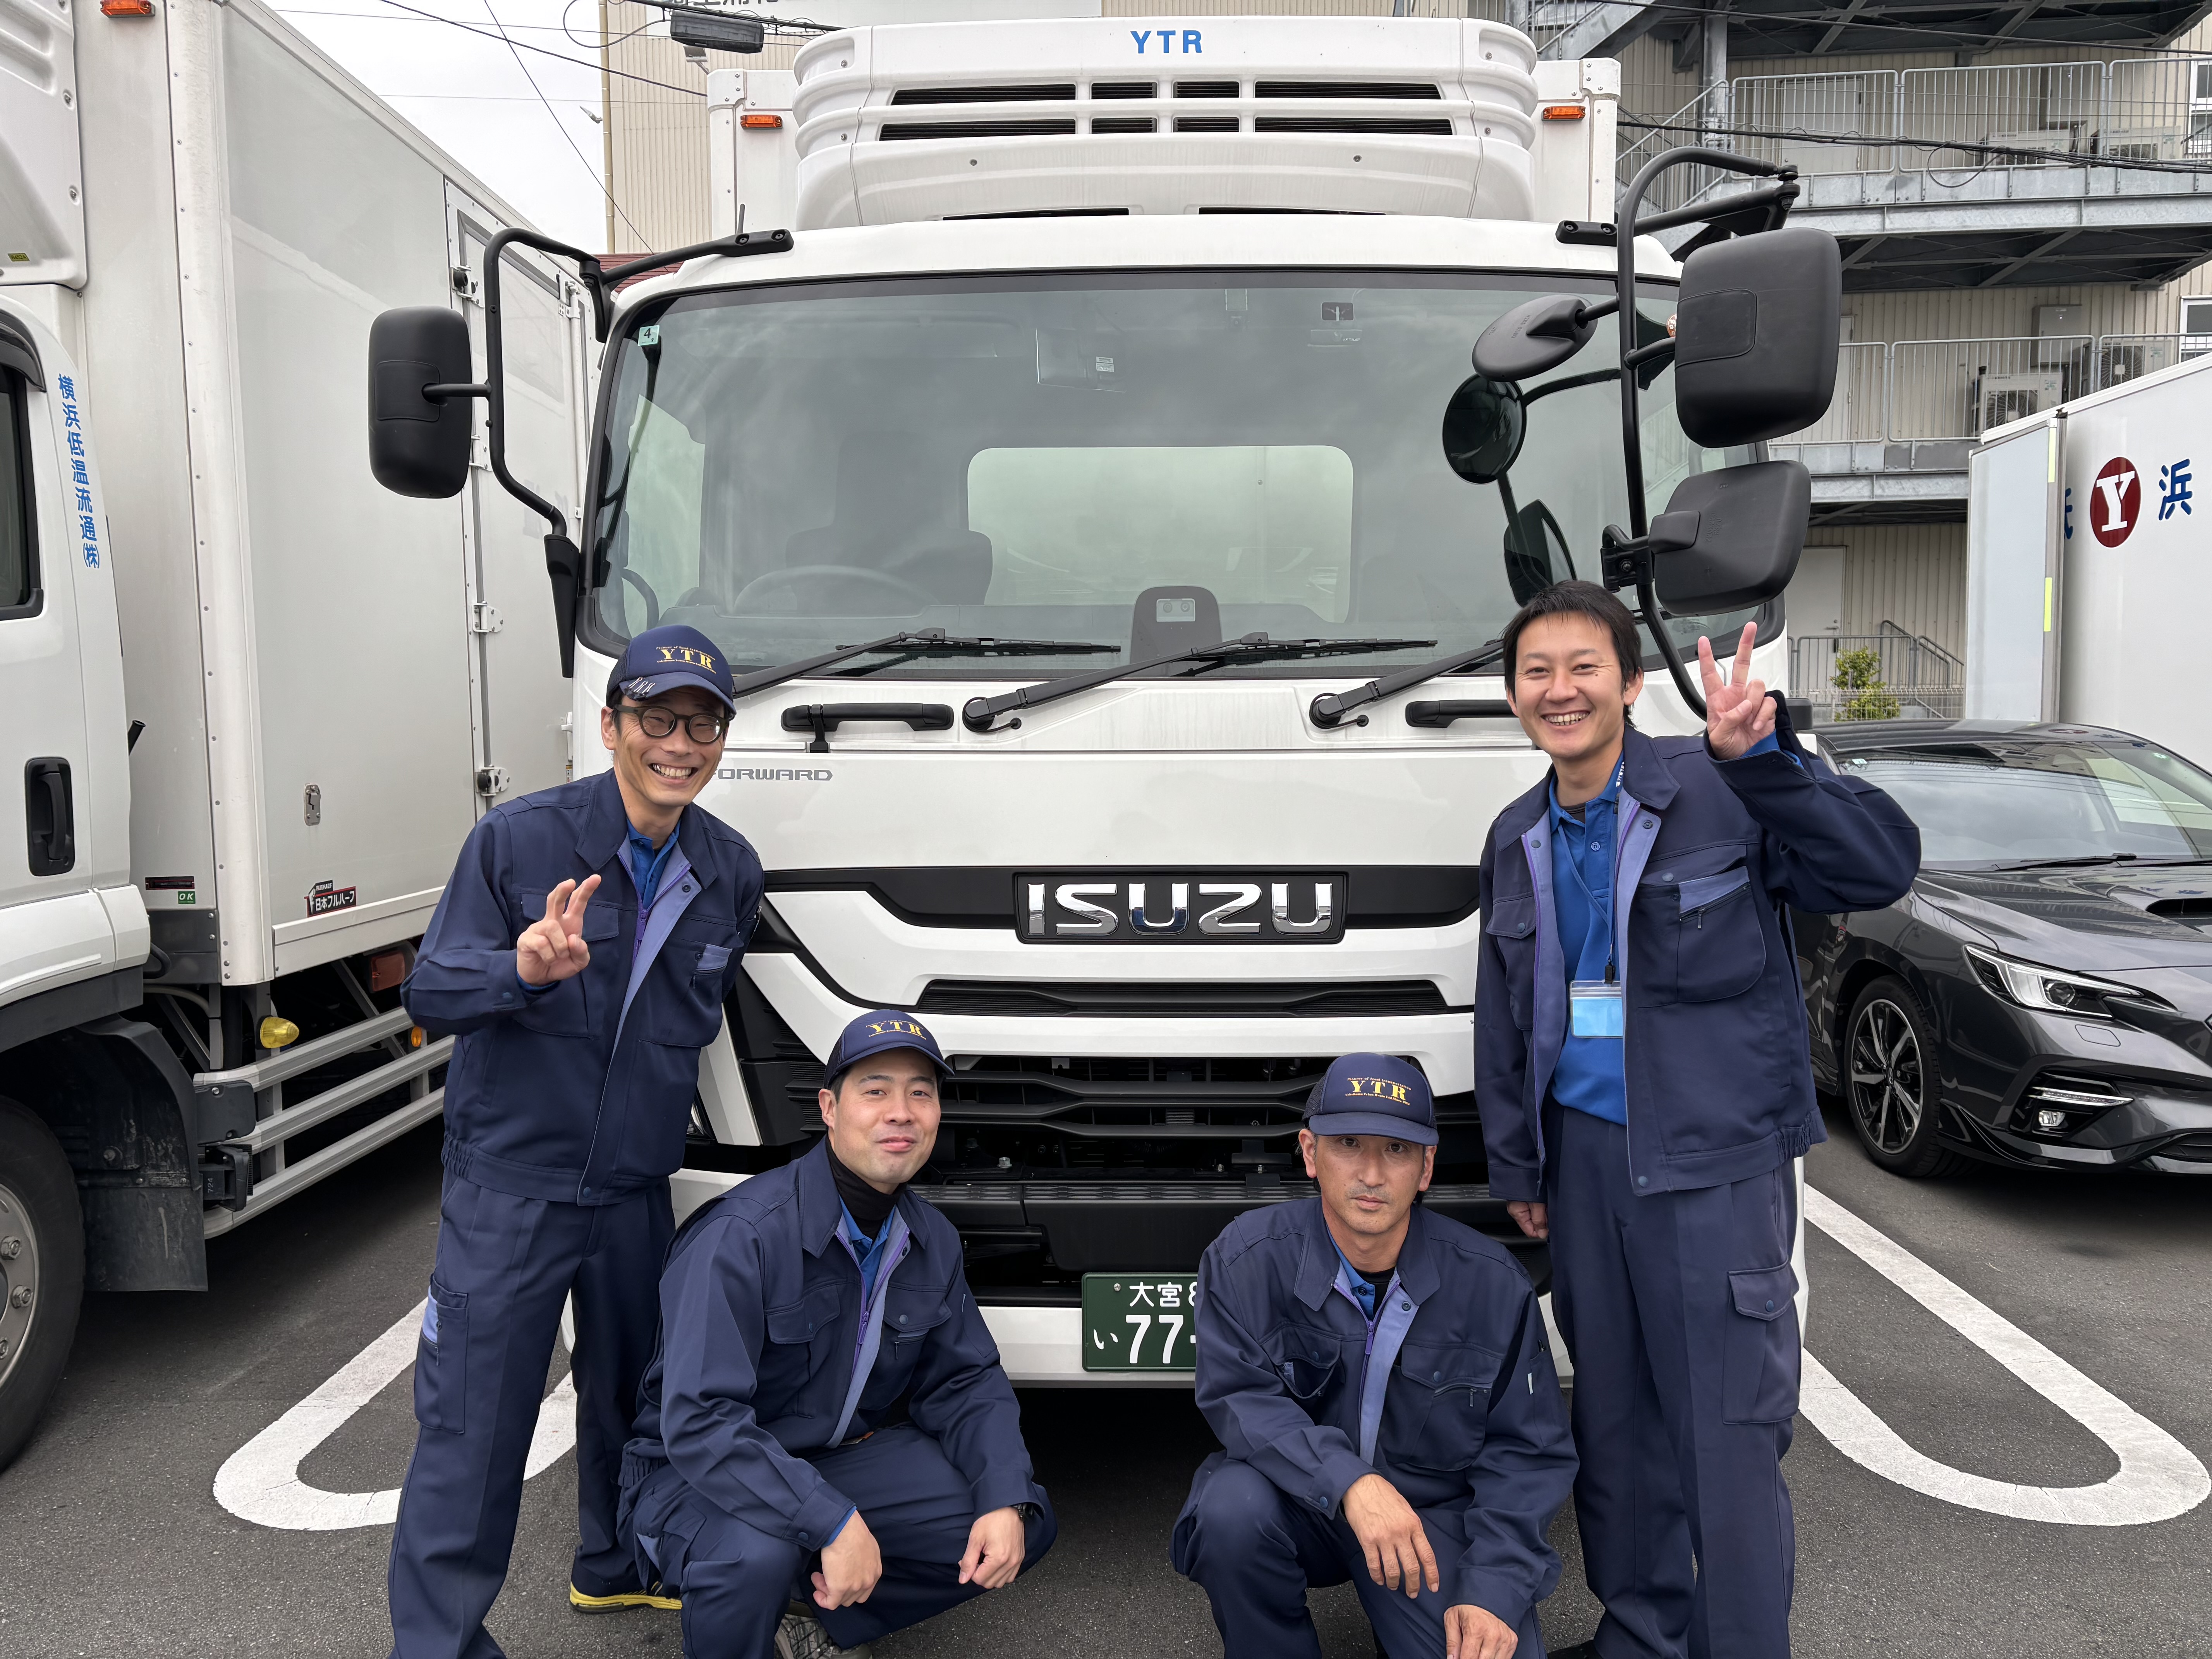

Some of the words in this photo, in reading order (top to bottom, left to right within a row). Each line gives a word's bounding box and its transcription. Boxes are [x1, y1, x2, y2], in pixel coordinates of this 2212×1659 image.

[1130, 30, 1202, 54] YTR
[644, 328, 651, 338] 4
[2096, 471, 2135, 532] Y
[661, 649, 713, 669] YTR
[714, 768, 833, 781] ORWARD
[315, 891, 354, 911] 日本フルハーフ
[1027, 883, 1333, 935] ISUZU
[870, 1022, 922, 1036] YTR
[1351, 1080, 1406, 1101] YTR
